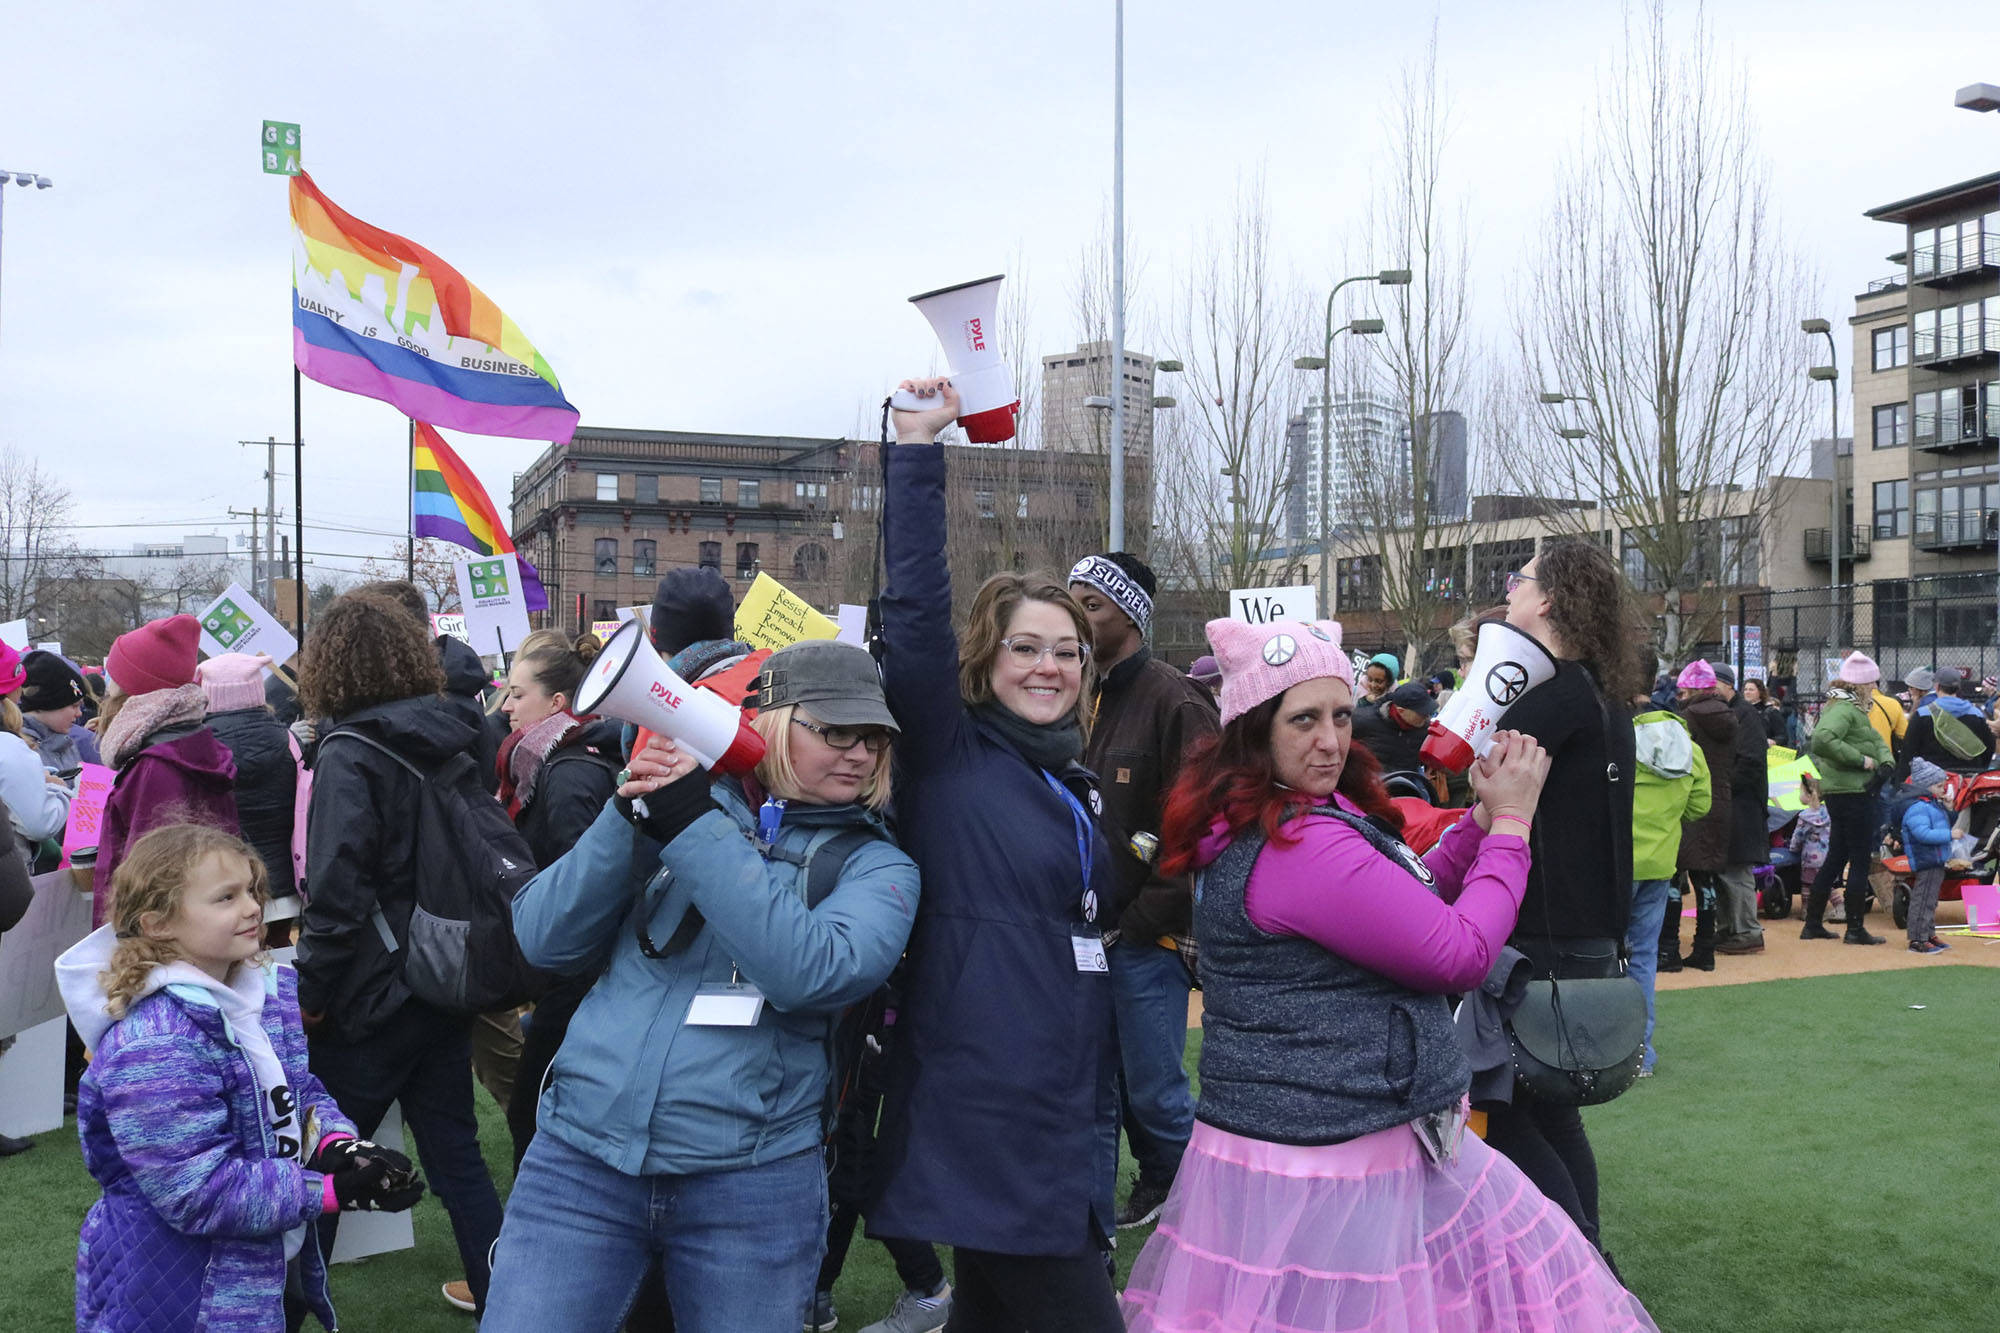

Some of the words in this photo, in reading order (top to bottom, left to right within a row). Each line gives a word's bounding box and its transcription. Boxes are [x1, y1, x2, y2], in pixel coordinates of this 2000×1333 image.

[363, 325, 377, 337] IS
[397, 336, 430, 357] GOOD
[1239, 597, 1285, 624] We
